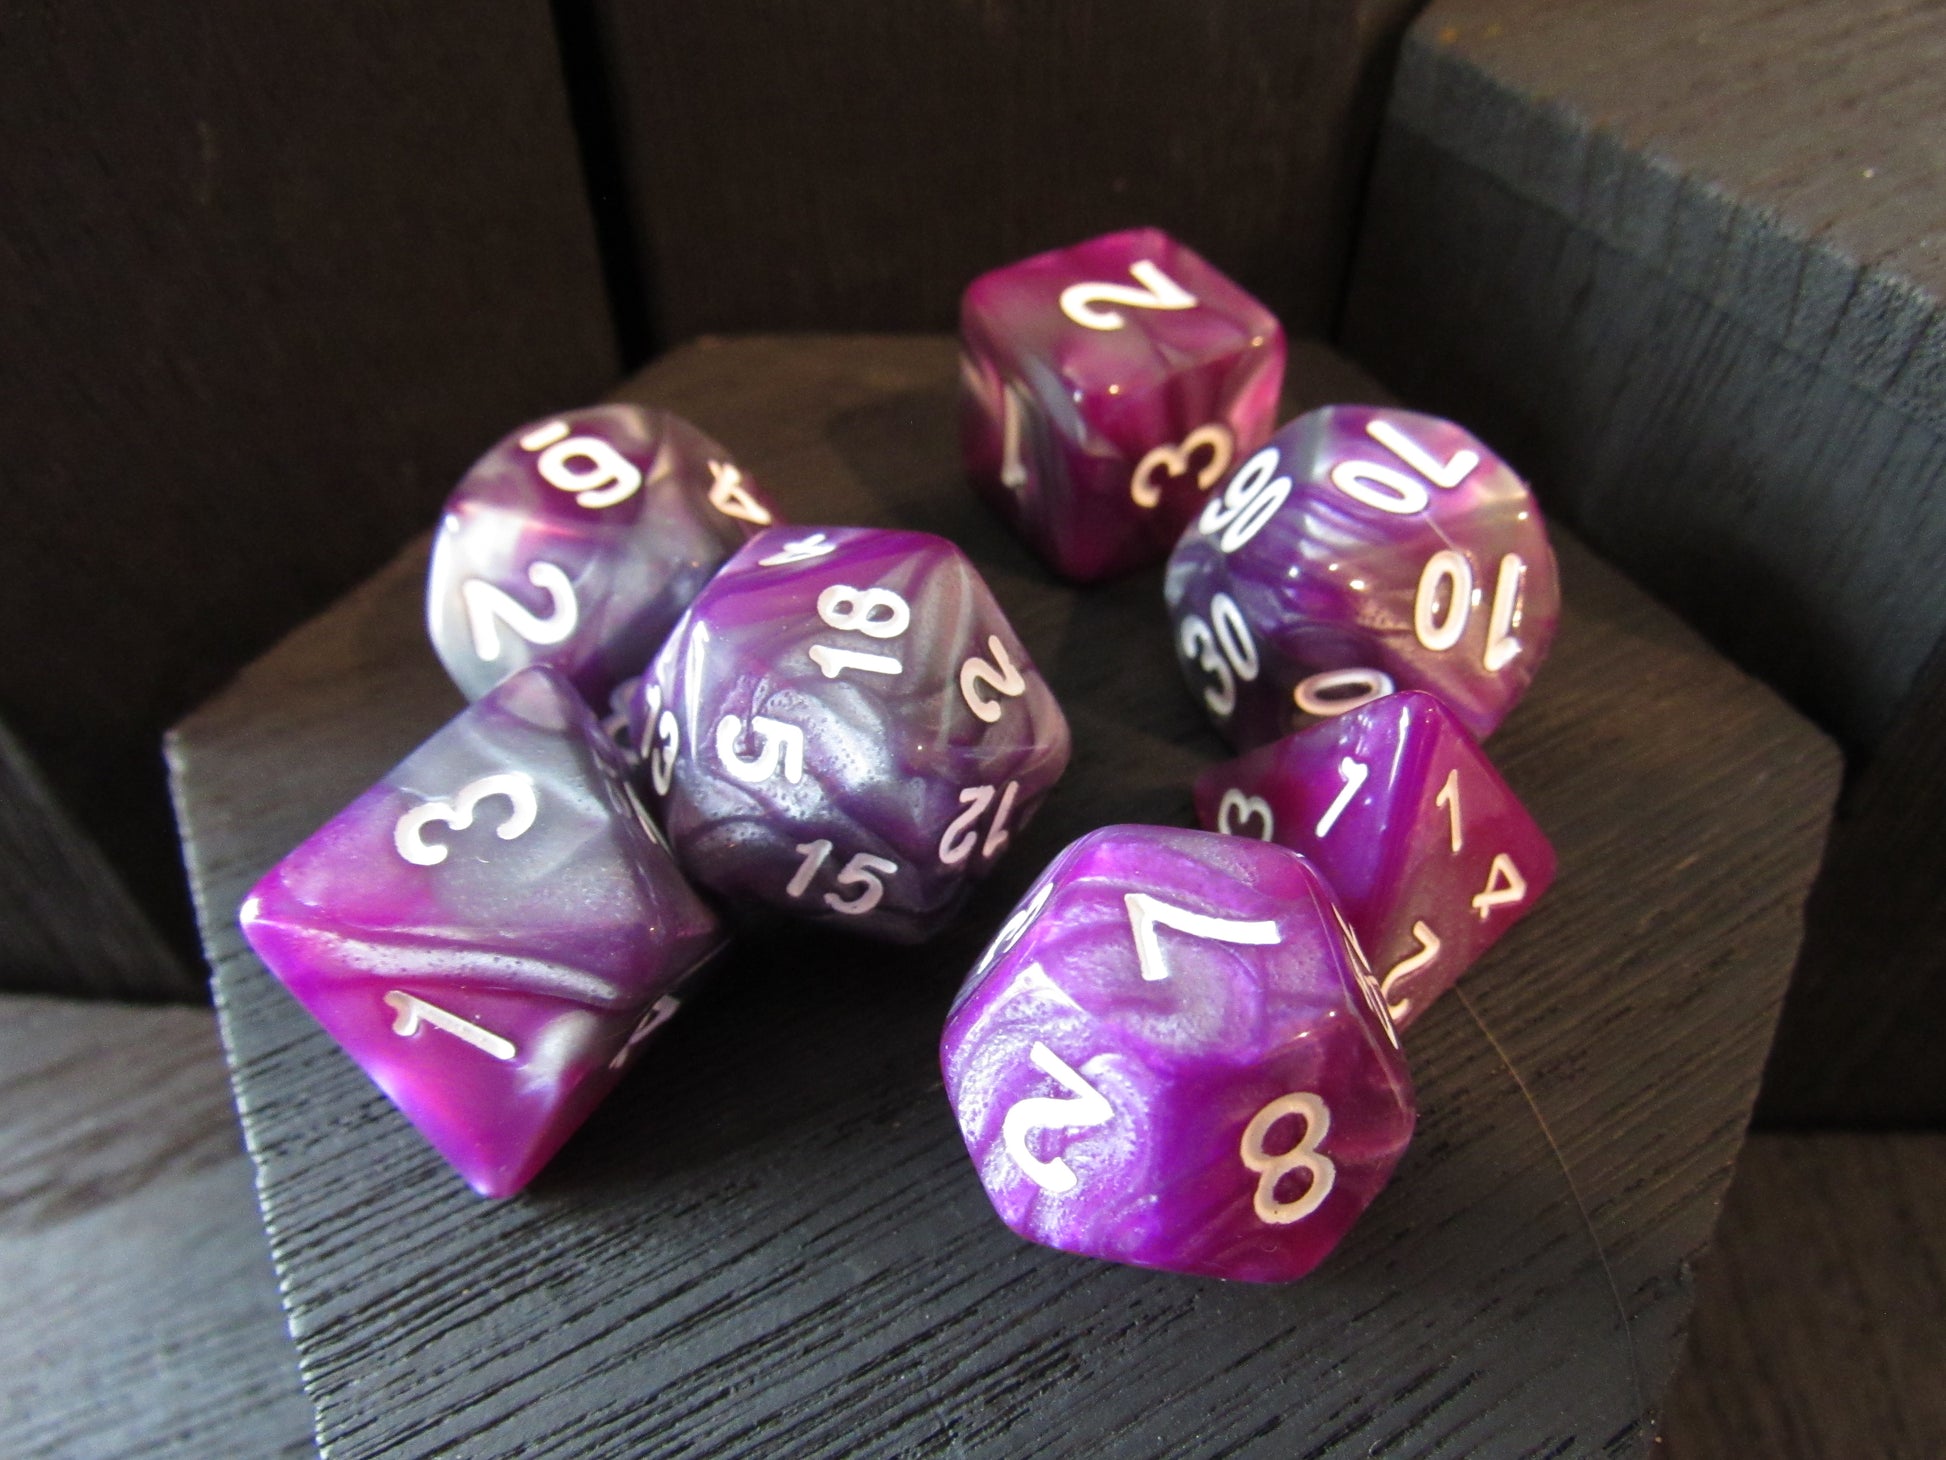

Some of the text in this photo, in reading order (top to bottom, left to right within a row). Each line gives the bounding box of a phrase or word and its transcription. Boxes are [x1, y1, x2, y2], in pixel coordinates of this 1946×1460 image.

[1058, 259, 1198, 331] 2
[537, 437, 642, 508] 6
[708, 459, 771, 525] 4
[1130, 423, 1234, 508] 3
[1199, 447, 1293, 553] 90
[1331, 419, 1480, 514] 70
[462, 561, 577, 662] 2
[808, 584, 910, 678] 18
[1414, 549, 1523, 672] 10
[959, 635, 1025, 723] 2
[1180, 592, 1260, 716] 30
[716, 714, 804, 784] 5
[394, 771, 538, 866] 3
[938, 781, 1018, 864] 12
[1218, 788, 1274, 842] 3
[1315, 756, 1368, 838] 1
[1435, 768, 1463, 853] 1
[786, 839, 898, 914] 15
[1471, 853, 1527, 920] 4
[1124, 893, 1281, 981] 7
[1381, 920, 1441, 1021] 2
[384, 990, 517, 1060] 1
[1002, 1040, 1114, 1193] 2
[1239, 1092, 1336, 1225] 8
